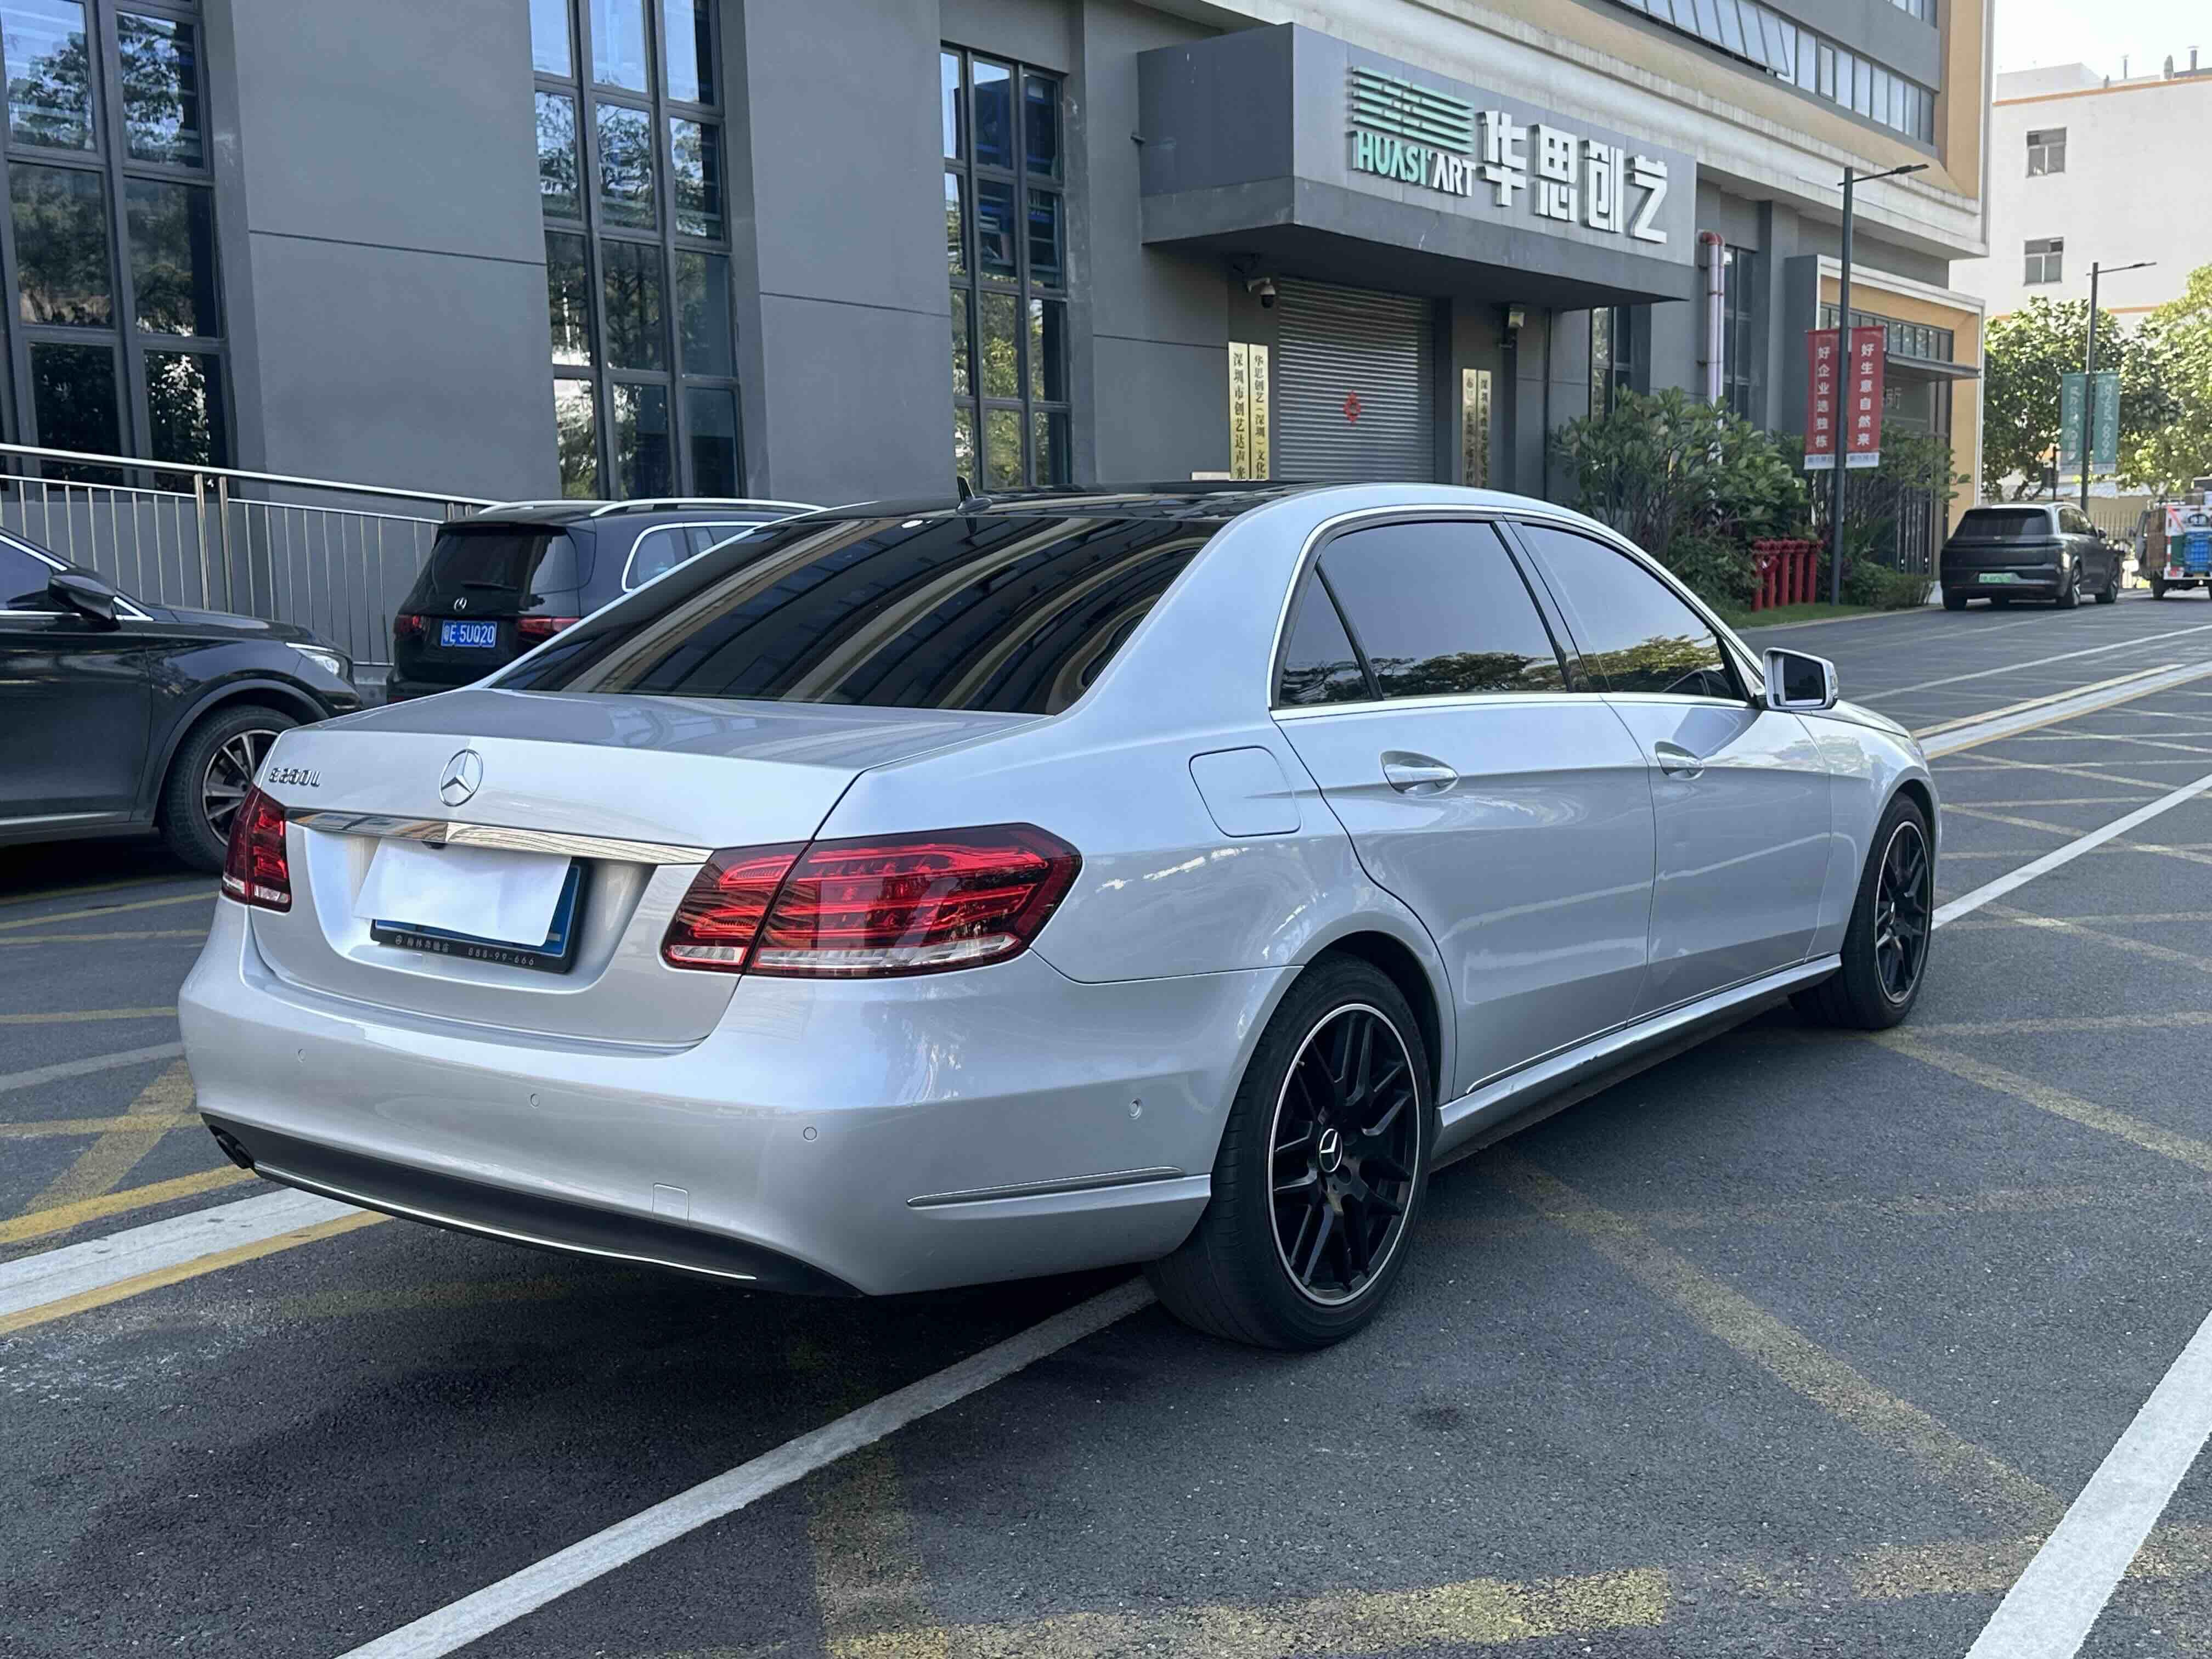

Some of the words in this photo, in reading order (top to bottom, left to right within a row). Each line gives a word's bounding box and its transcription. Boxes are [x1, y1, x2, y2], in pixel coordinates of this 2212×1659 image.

[1478, 110, 1668, 244] 华思创艺
[1857, 342, 1874, 447] 好生意自然来
